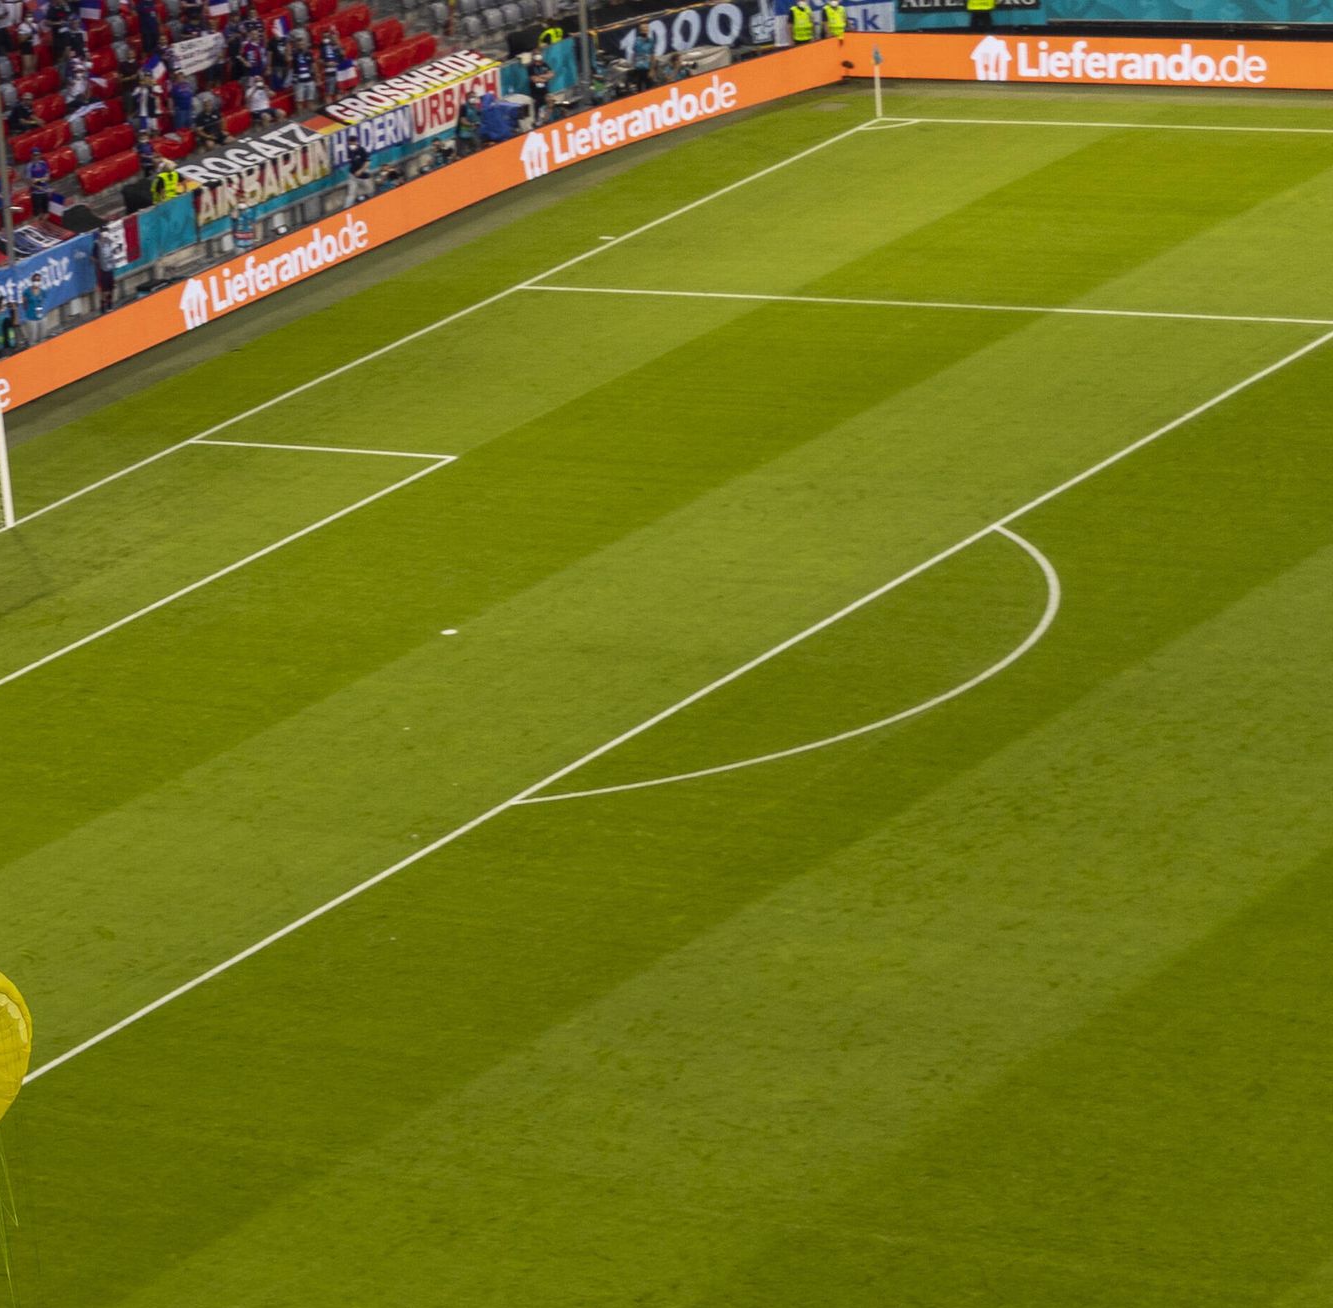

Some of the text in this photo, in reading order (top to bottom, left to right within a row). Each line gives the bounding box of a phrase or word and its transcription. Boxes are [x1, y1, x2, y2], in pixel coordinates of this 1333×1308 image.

[325, 50, 492, 124] GROSSHEIDE
[1017, 38, 1267, 84] Lieferando.de
[175, 122, 324, 184] ROGÄTZ
[333, 105, 411, 166] HDERN
[551, 74, 737, 165] Lieferando.de
[208, 213, 369, 312] Lieferando.de
